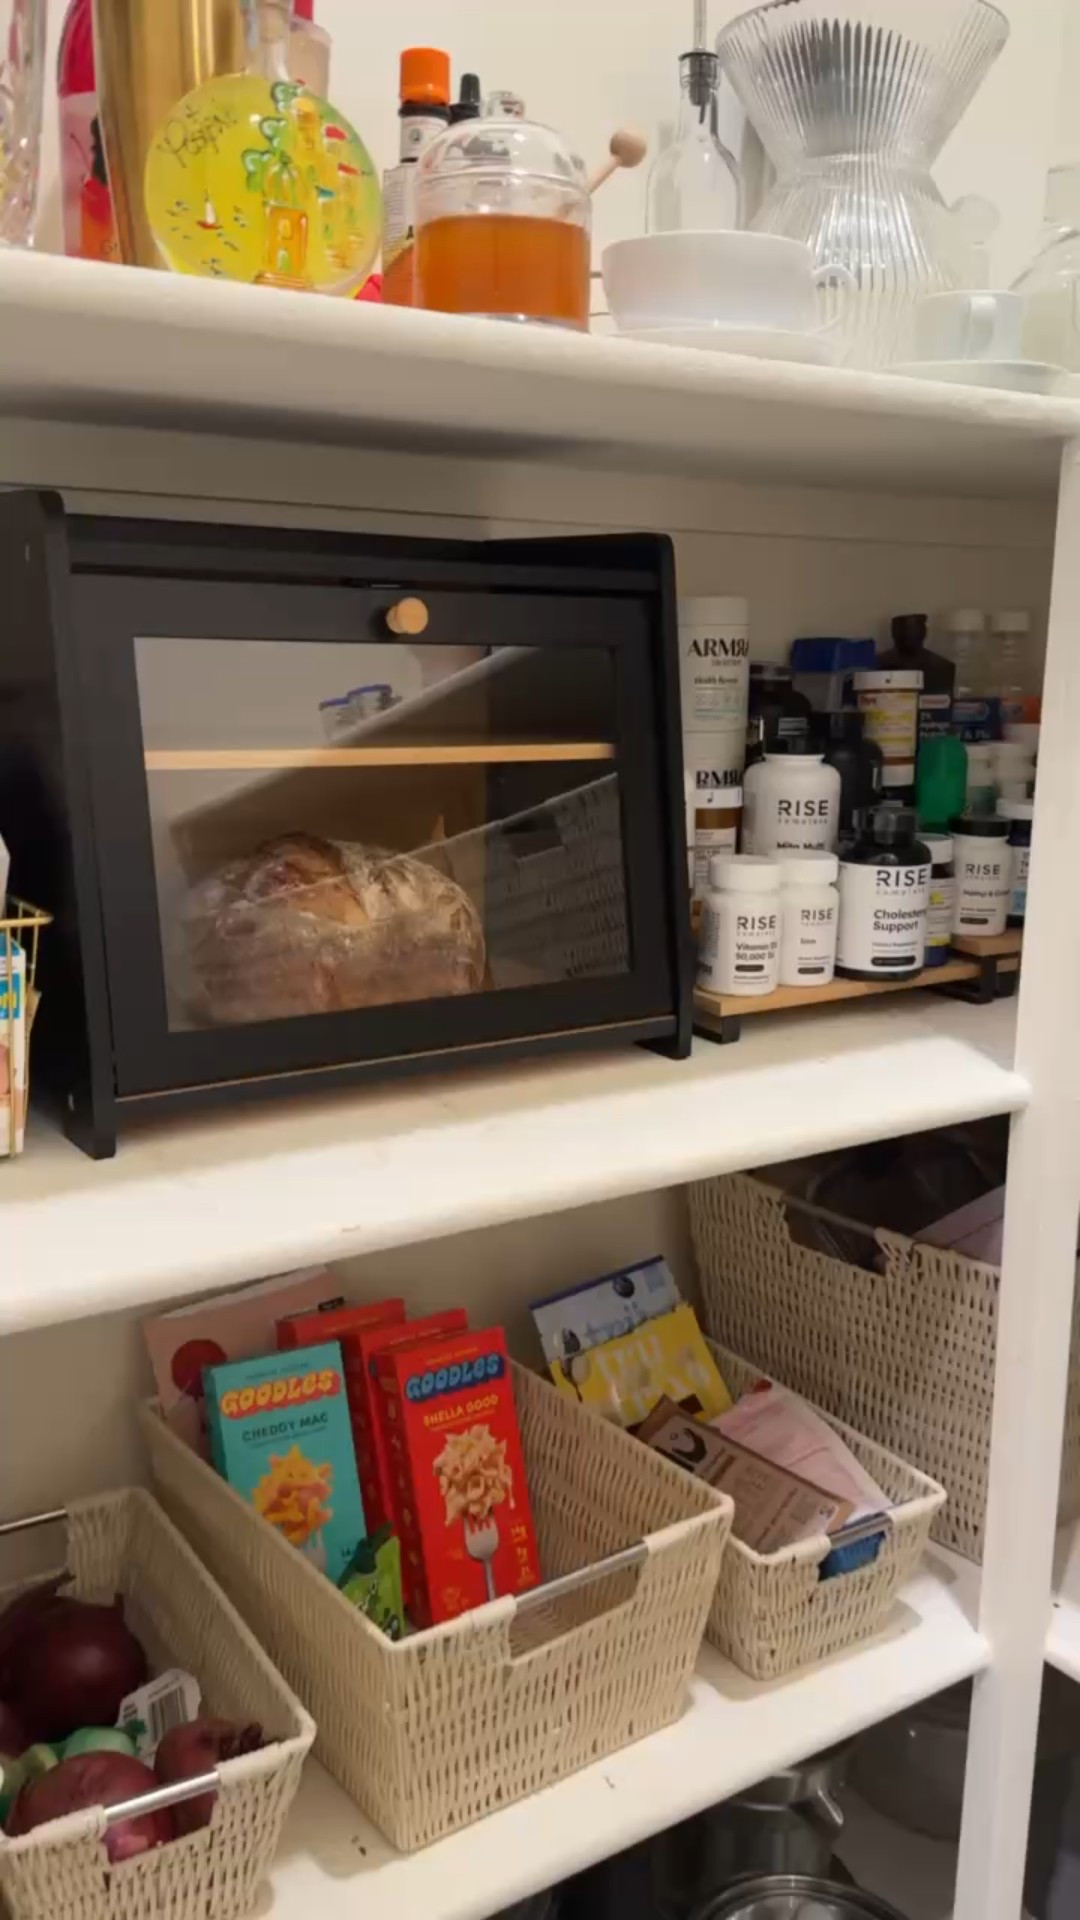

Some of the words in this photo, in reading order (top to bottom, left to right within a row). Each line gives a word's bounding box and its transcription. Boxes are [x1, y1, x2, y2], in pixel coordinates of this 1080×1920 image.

[778, 800, 829, 817] RISE
[876, 868, 928, 887] RISE
[965, 863, 1001, 875] RISE
[737, 915, 777, 930] RISE
[801, 908, 834, 921] RISE
[873, 921, 918, 933] Support
[220, 1368, 337, 1418] GOODLES
[466, 1393, 499, 1413] GOOD
[241, 1421, 295, 1442] CHEDDY
[300, 1412, 328, 1428] MAC
